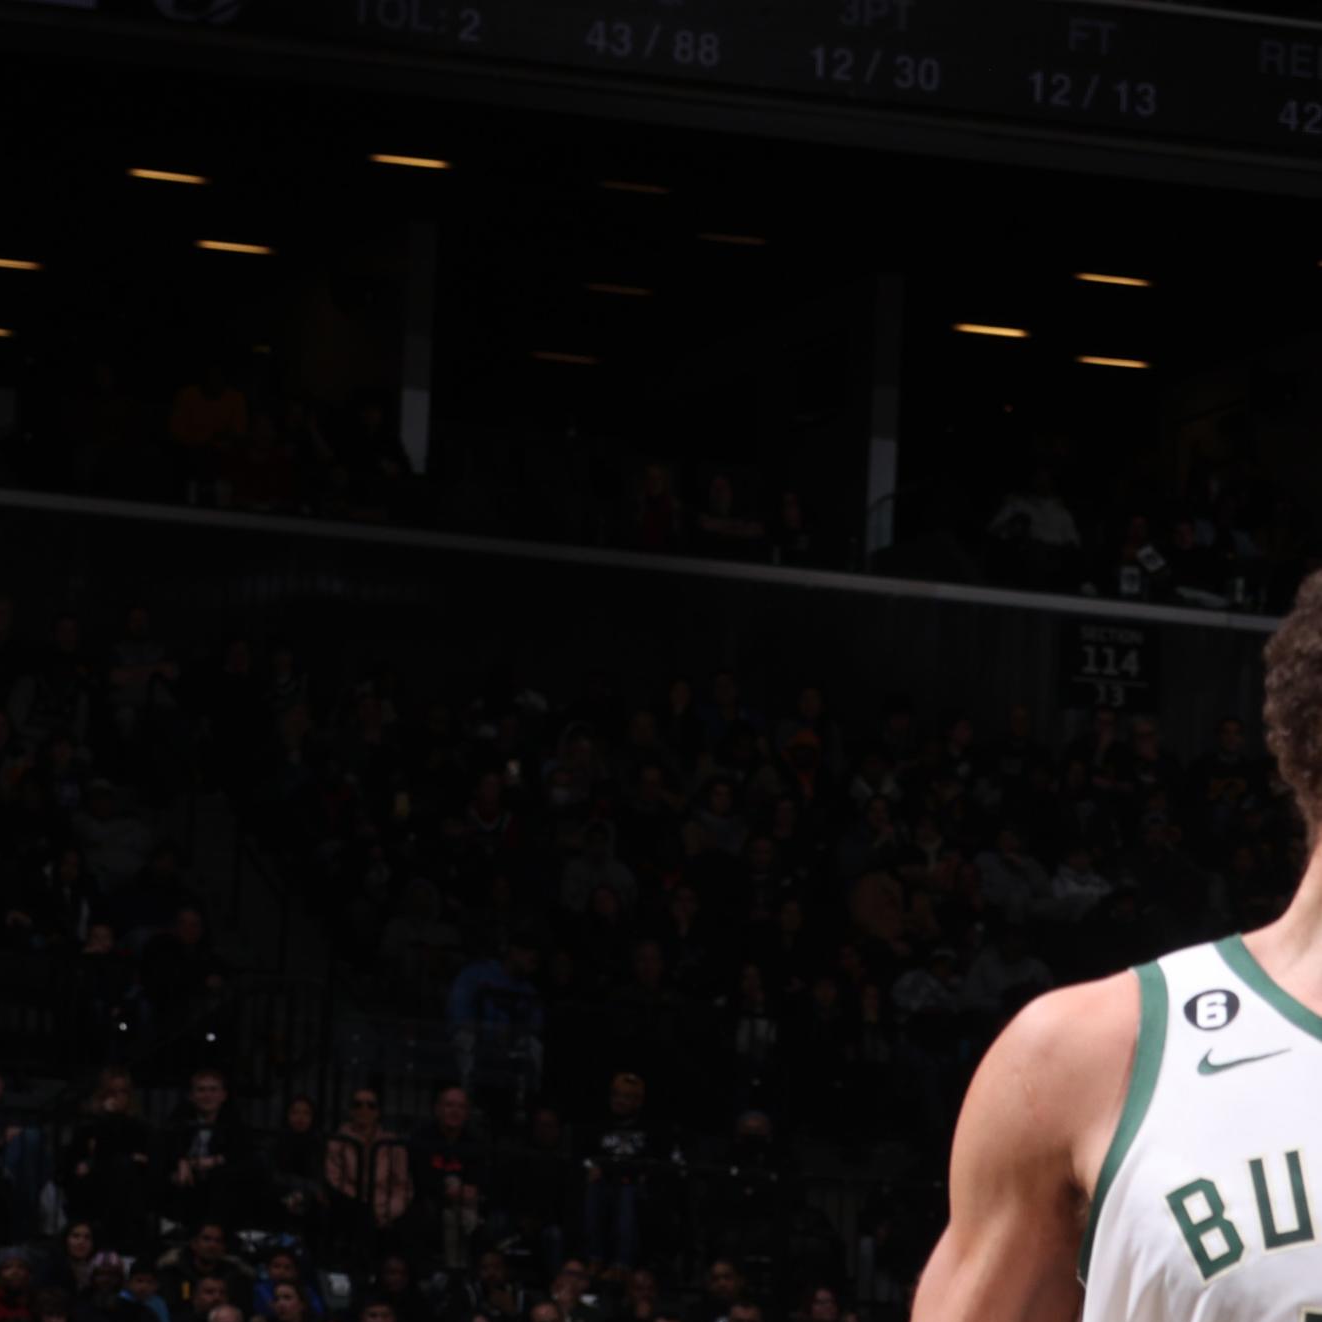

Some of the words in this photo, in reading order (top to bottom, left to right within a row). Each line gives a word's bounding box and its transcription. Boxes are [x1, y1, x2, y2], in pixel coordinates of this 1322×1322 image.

[1068, 16, 1118, 54] FT
[1259, 38, 1322, 80] RE
[1080, 643, 1141, 679] 114
[1195, 990, 1229, 1031] 6
